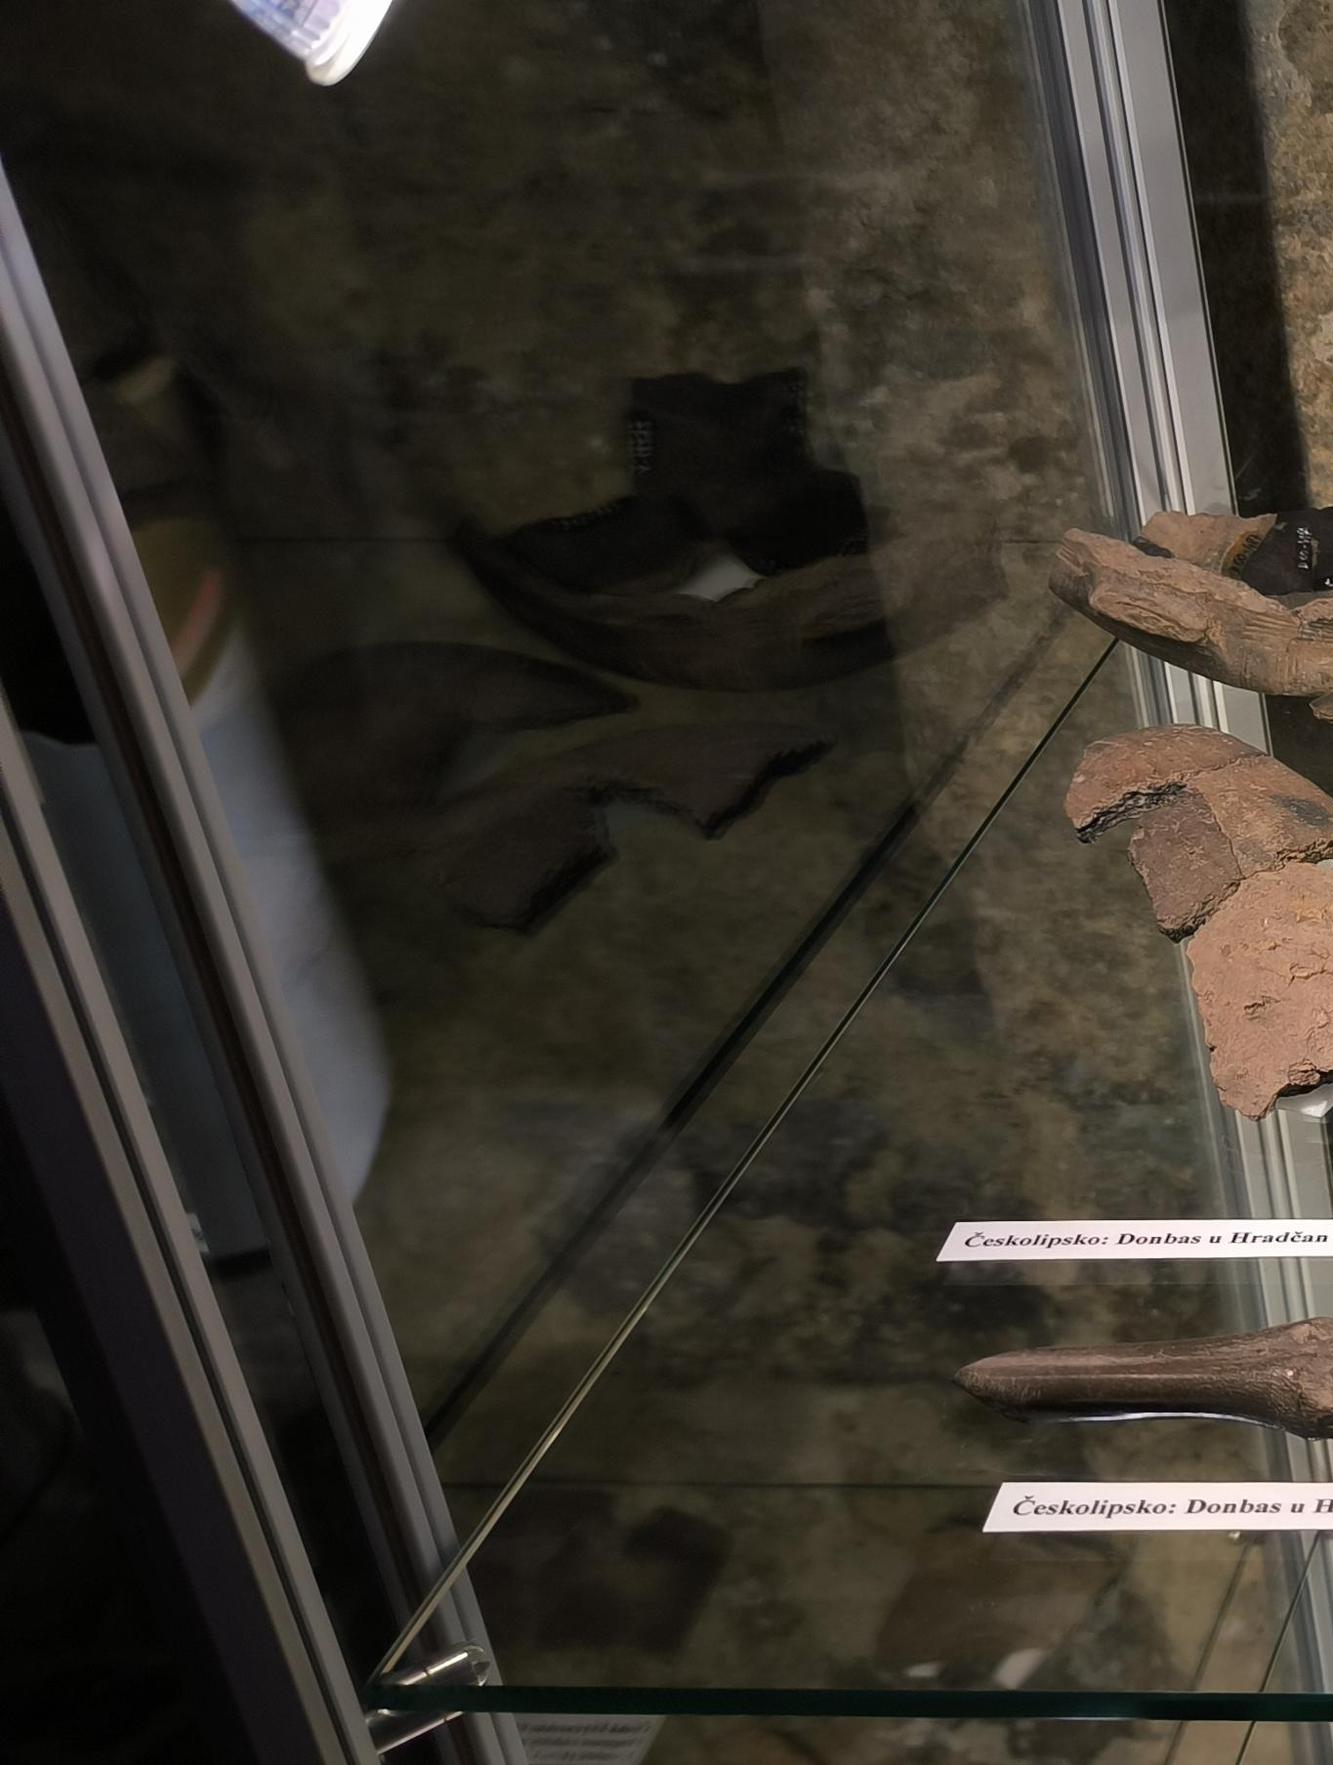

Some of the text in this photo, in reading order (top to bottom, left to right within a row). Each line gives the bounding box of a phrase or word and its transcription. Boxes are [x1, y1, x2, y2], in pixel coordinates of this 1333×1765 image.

[964, 1231, 1329, 1249] Českolipsko: Donbas u Hradčan
[1012, 1495, 1177, 1519] Českolipsko:
[1185, 1498, 1282, 1514] Donbas
[1290, 1503, 1305, 1514] u
